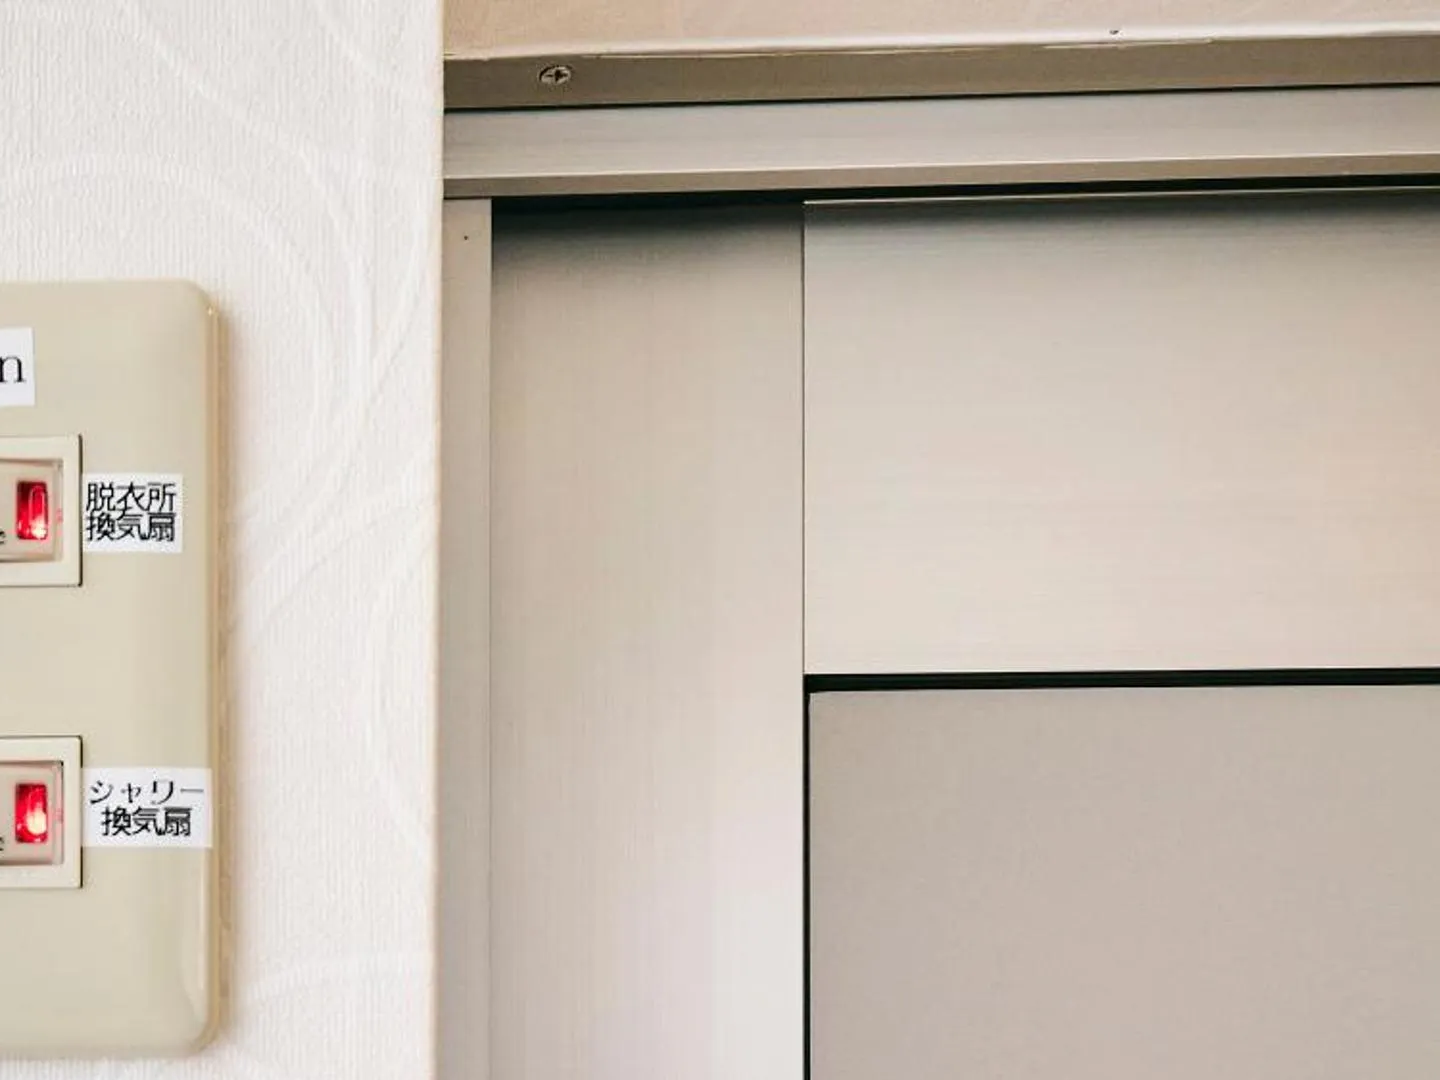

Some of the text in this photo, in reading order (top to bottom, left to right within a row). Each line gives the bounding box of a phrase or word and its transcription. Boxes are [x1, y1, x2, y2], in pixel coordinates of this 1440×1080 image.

[86, 481, 177, 512] 脱衣所
[86, 512, 177, 543] 換気扇
[89, 779, 205, 805] シャワー
[100, 806, 193, 837] 換気扇
